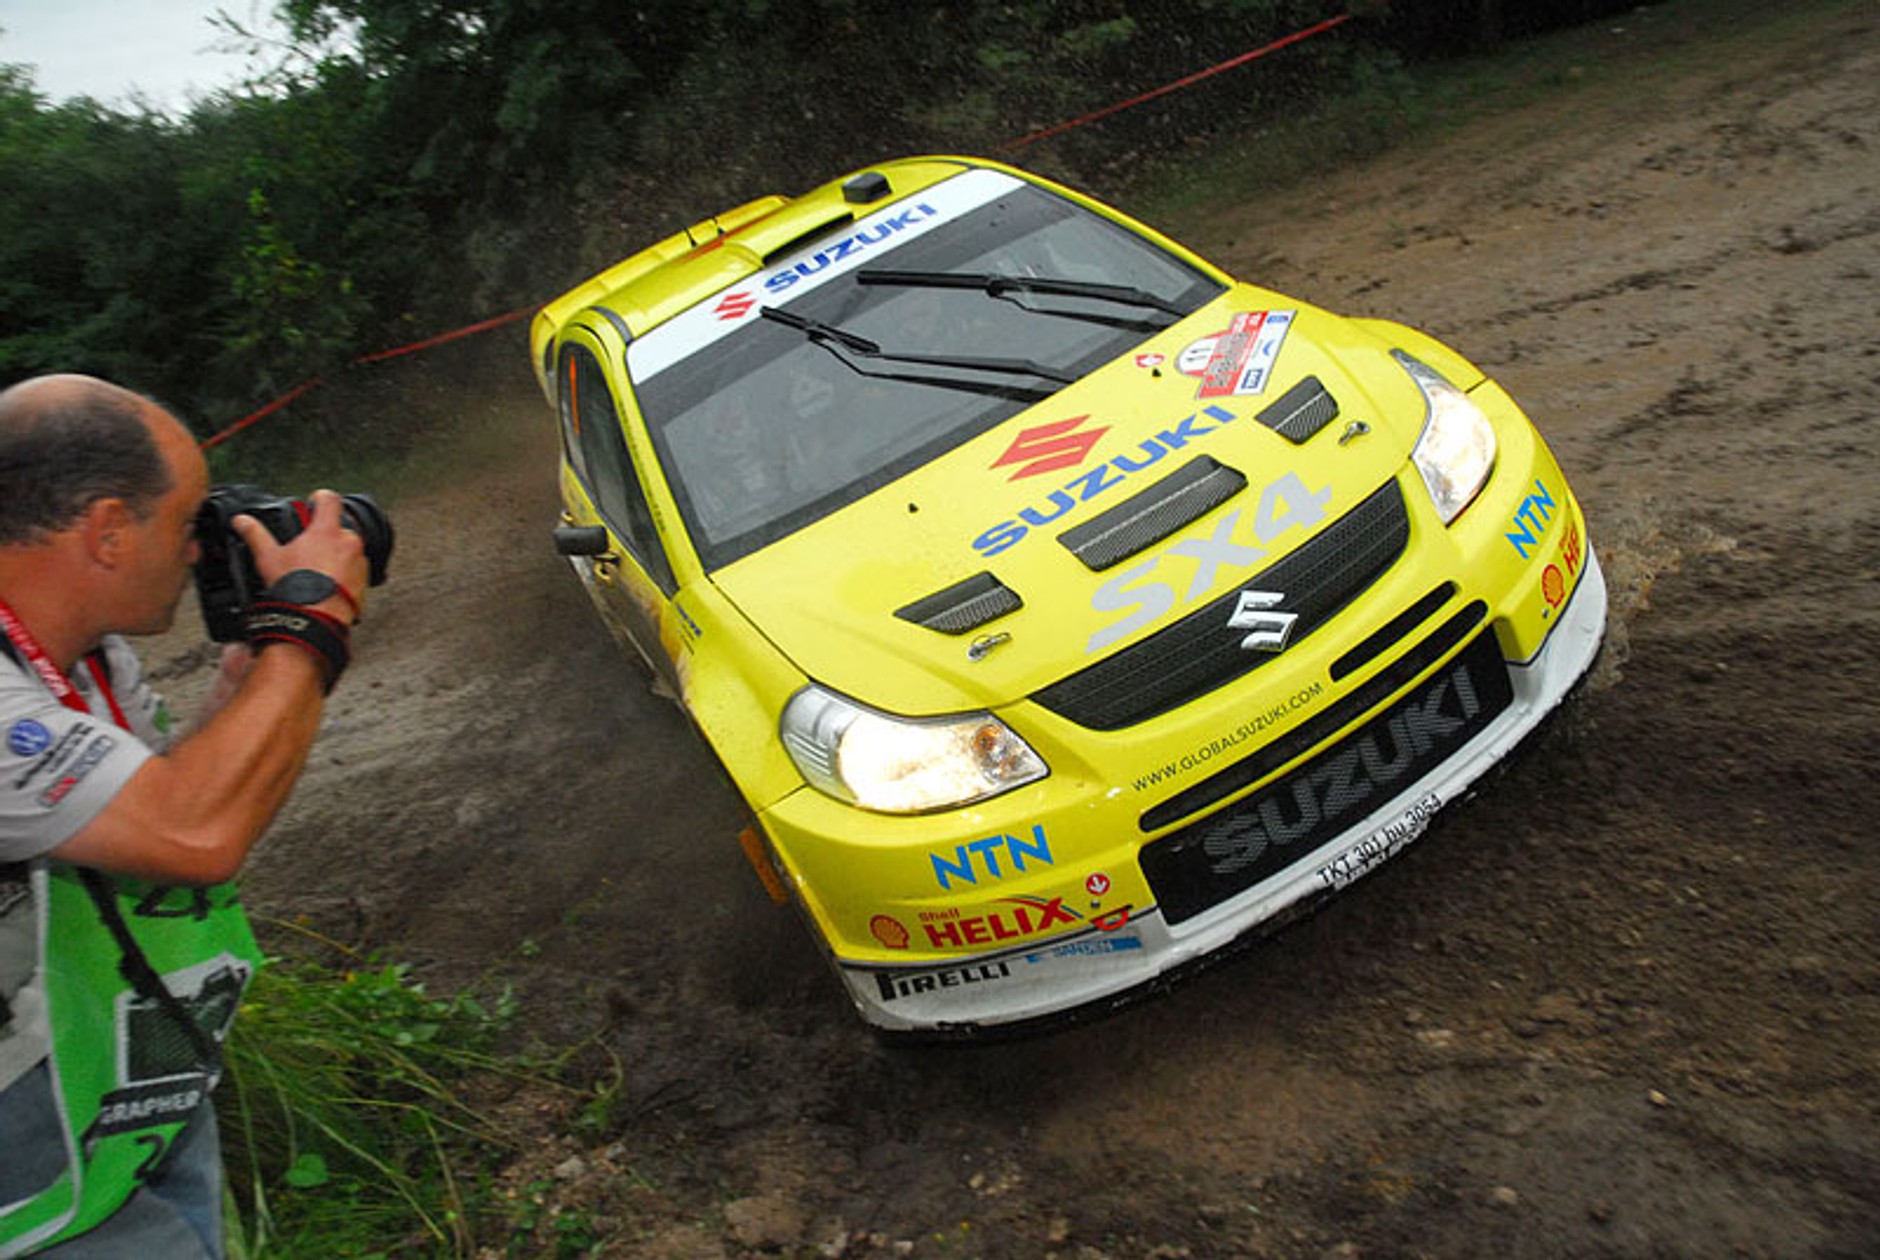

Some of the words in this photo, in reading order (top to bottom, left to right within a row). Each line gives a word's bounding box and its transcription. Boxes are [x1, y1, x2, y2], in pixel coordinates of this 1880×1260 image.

[764, 203, 937, 293] SUZUKI
[971, 404, 1237, 558] SUZUKI
[1504, 479, 1556, 559] NTN
[1084, 470, 1333, 655] SX4
[1131, 682, 1323, 792] WWW.GLOBALSUZUKI.COM
[1203, 665, 1480, 874] SUZUKI
[929, 825, 1054, 890] NTN
[1316, 854, 1350, 884] TKT
[1353, 835, 1384, 862] 301
[1405, 793, 1442, 828] 3054
[918, 908, 961, 921] Shell
[923, 897, 1078, 949] HELIX
[873, 961, 1011, 1002] PIRELLI
